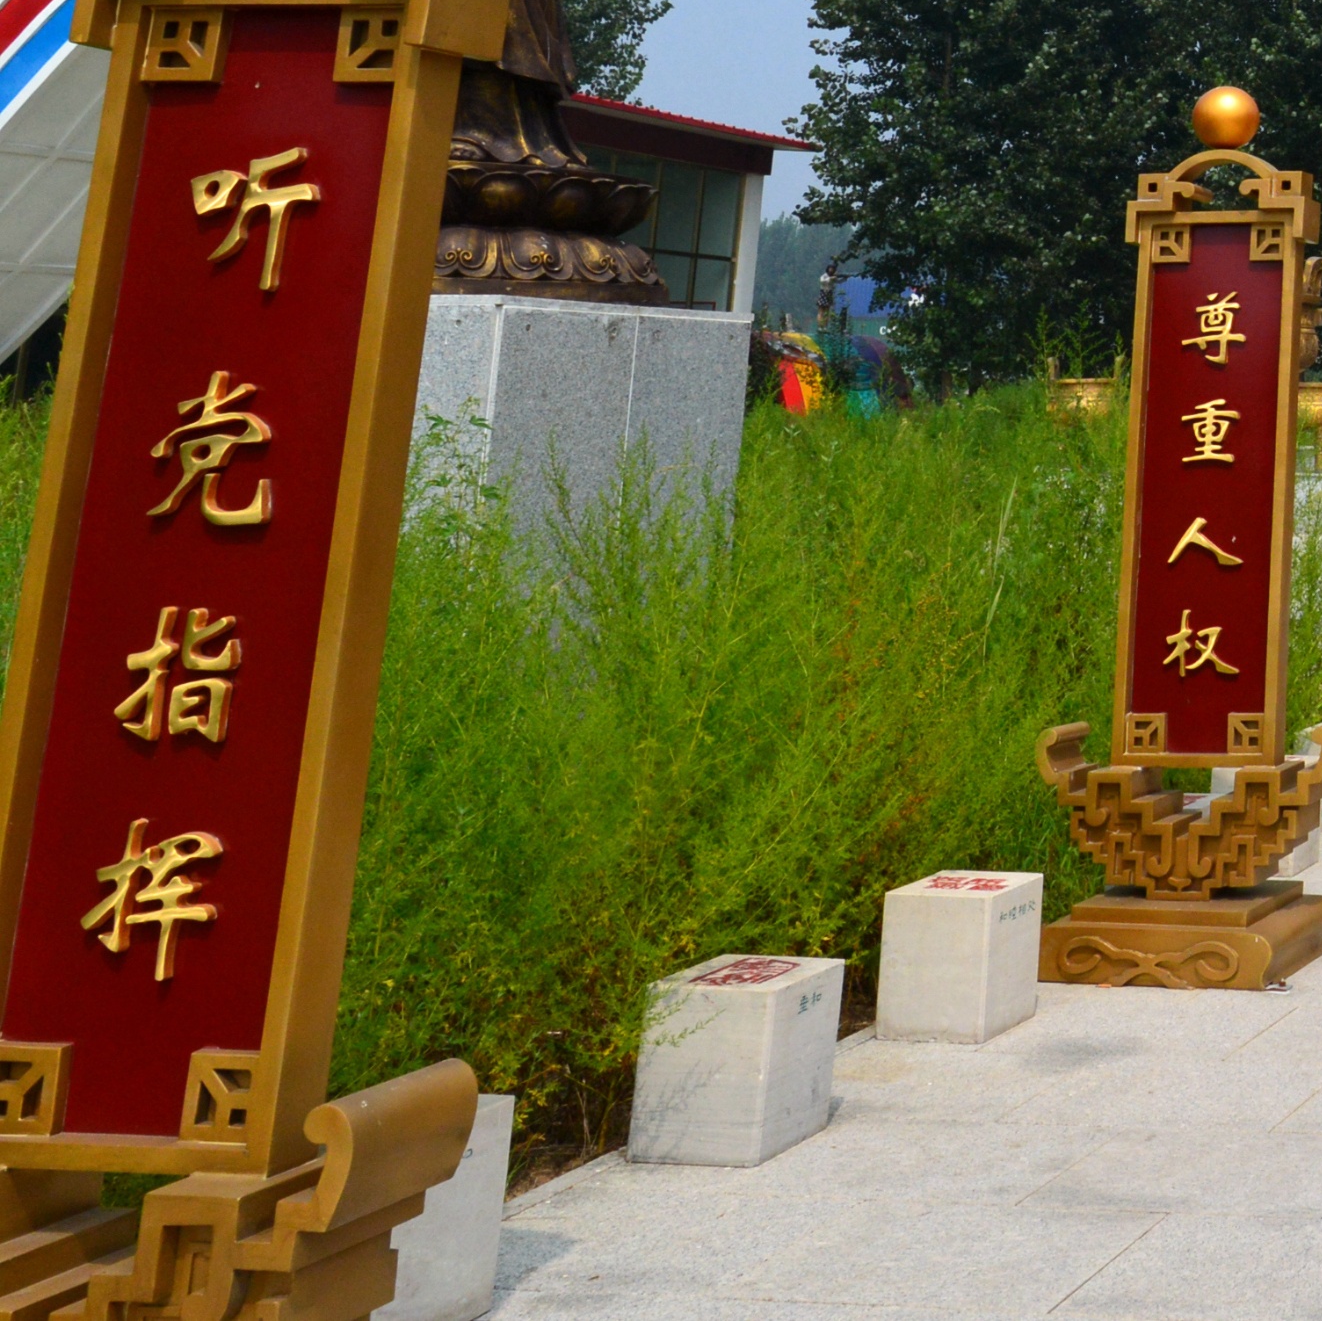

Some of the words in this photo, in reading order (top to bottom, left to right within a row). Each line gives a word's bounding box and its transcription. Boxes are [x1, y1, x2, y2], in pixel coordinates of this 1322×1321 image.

[80, 145, 321, 982] 听党指挥
[1162, 291, 1247, 677] 尊重人权
